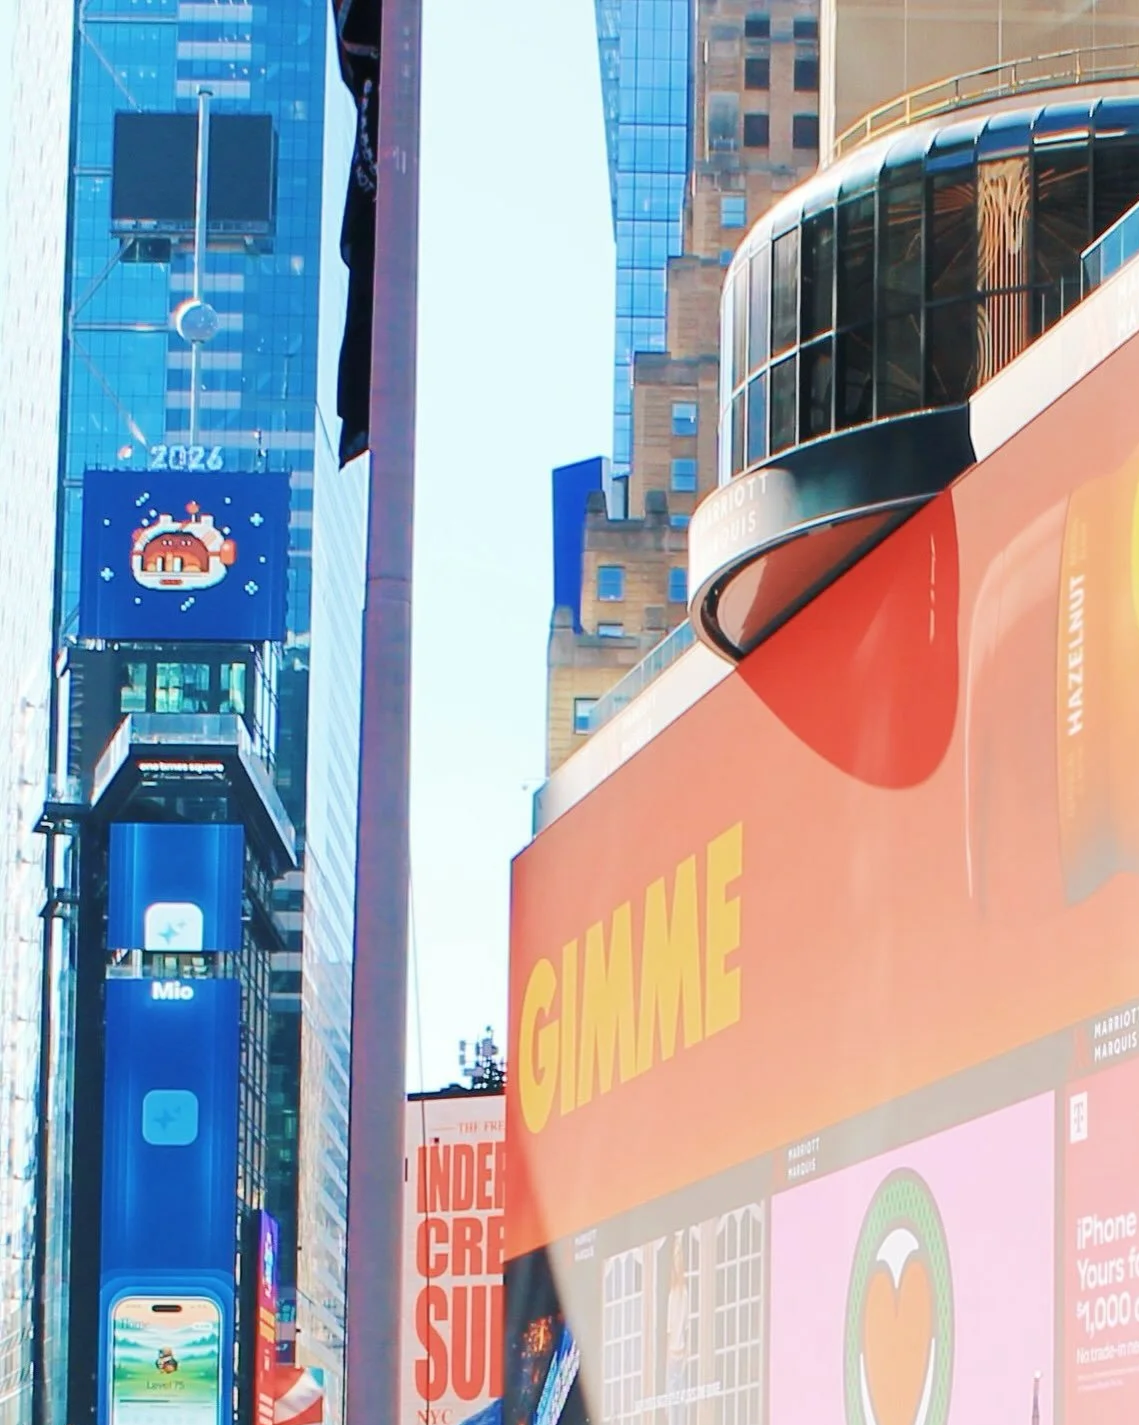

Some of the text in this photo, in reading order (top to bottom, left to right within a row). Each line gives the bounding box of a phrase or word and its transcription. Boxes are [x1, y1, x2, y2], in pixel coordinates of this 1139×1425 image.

[148, 445, 224, 471] 2026
[1069, 573, 1086, 737] HAZELNUT
[152, 981, 194, 1000] Mio
[519, 820, 743, 1134] GIMME
[1094, 1031, 1138, 1062] MARQUIS
[1076, 1211, 1137, 1250] iPhone
[1077, 1256, 1125, 1291] Yours
[1076, 1291, 1131, 1339] $1,000
[417, 1409, 453, 1425] NYC
